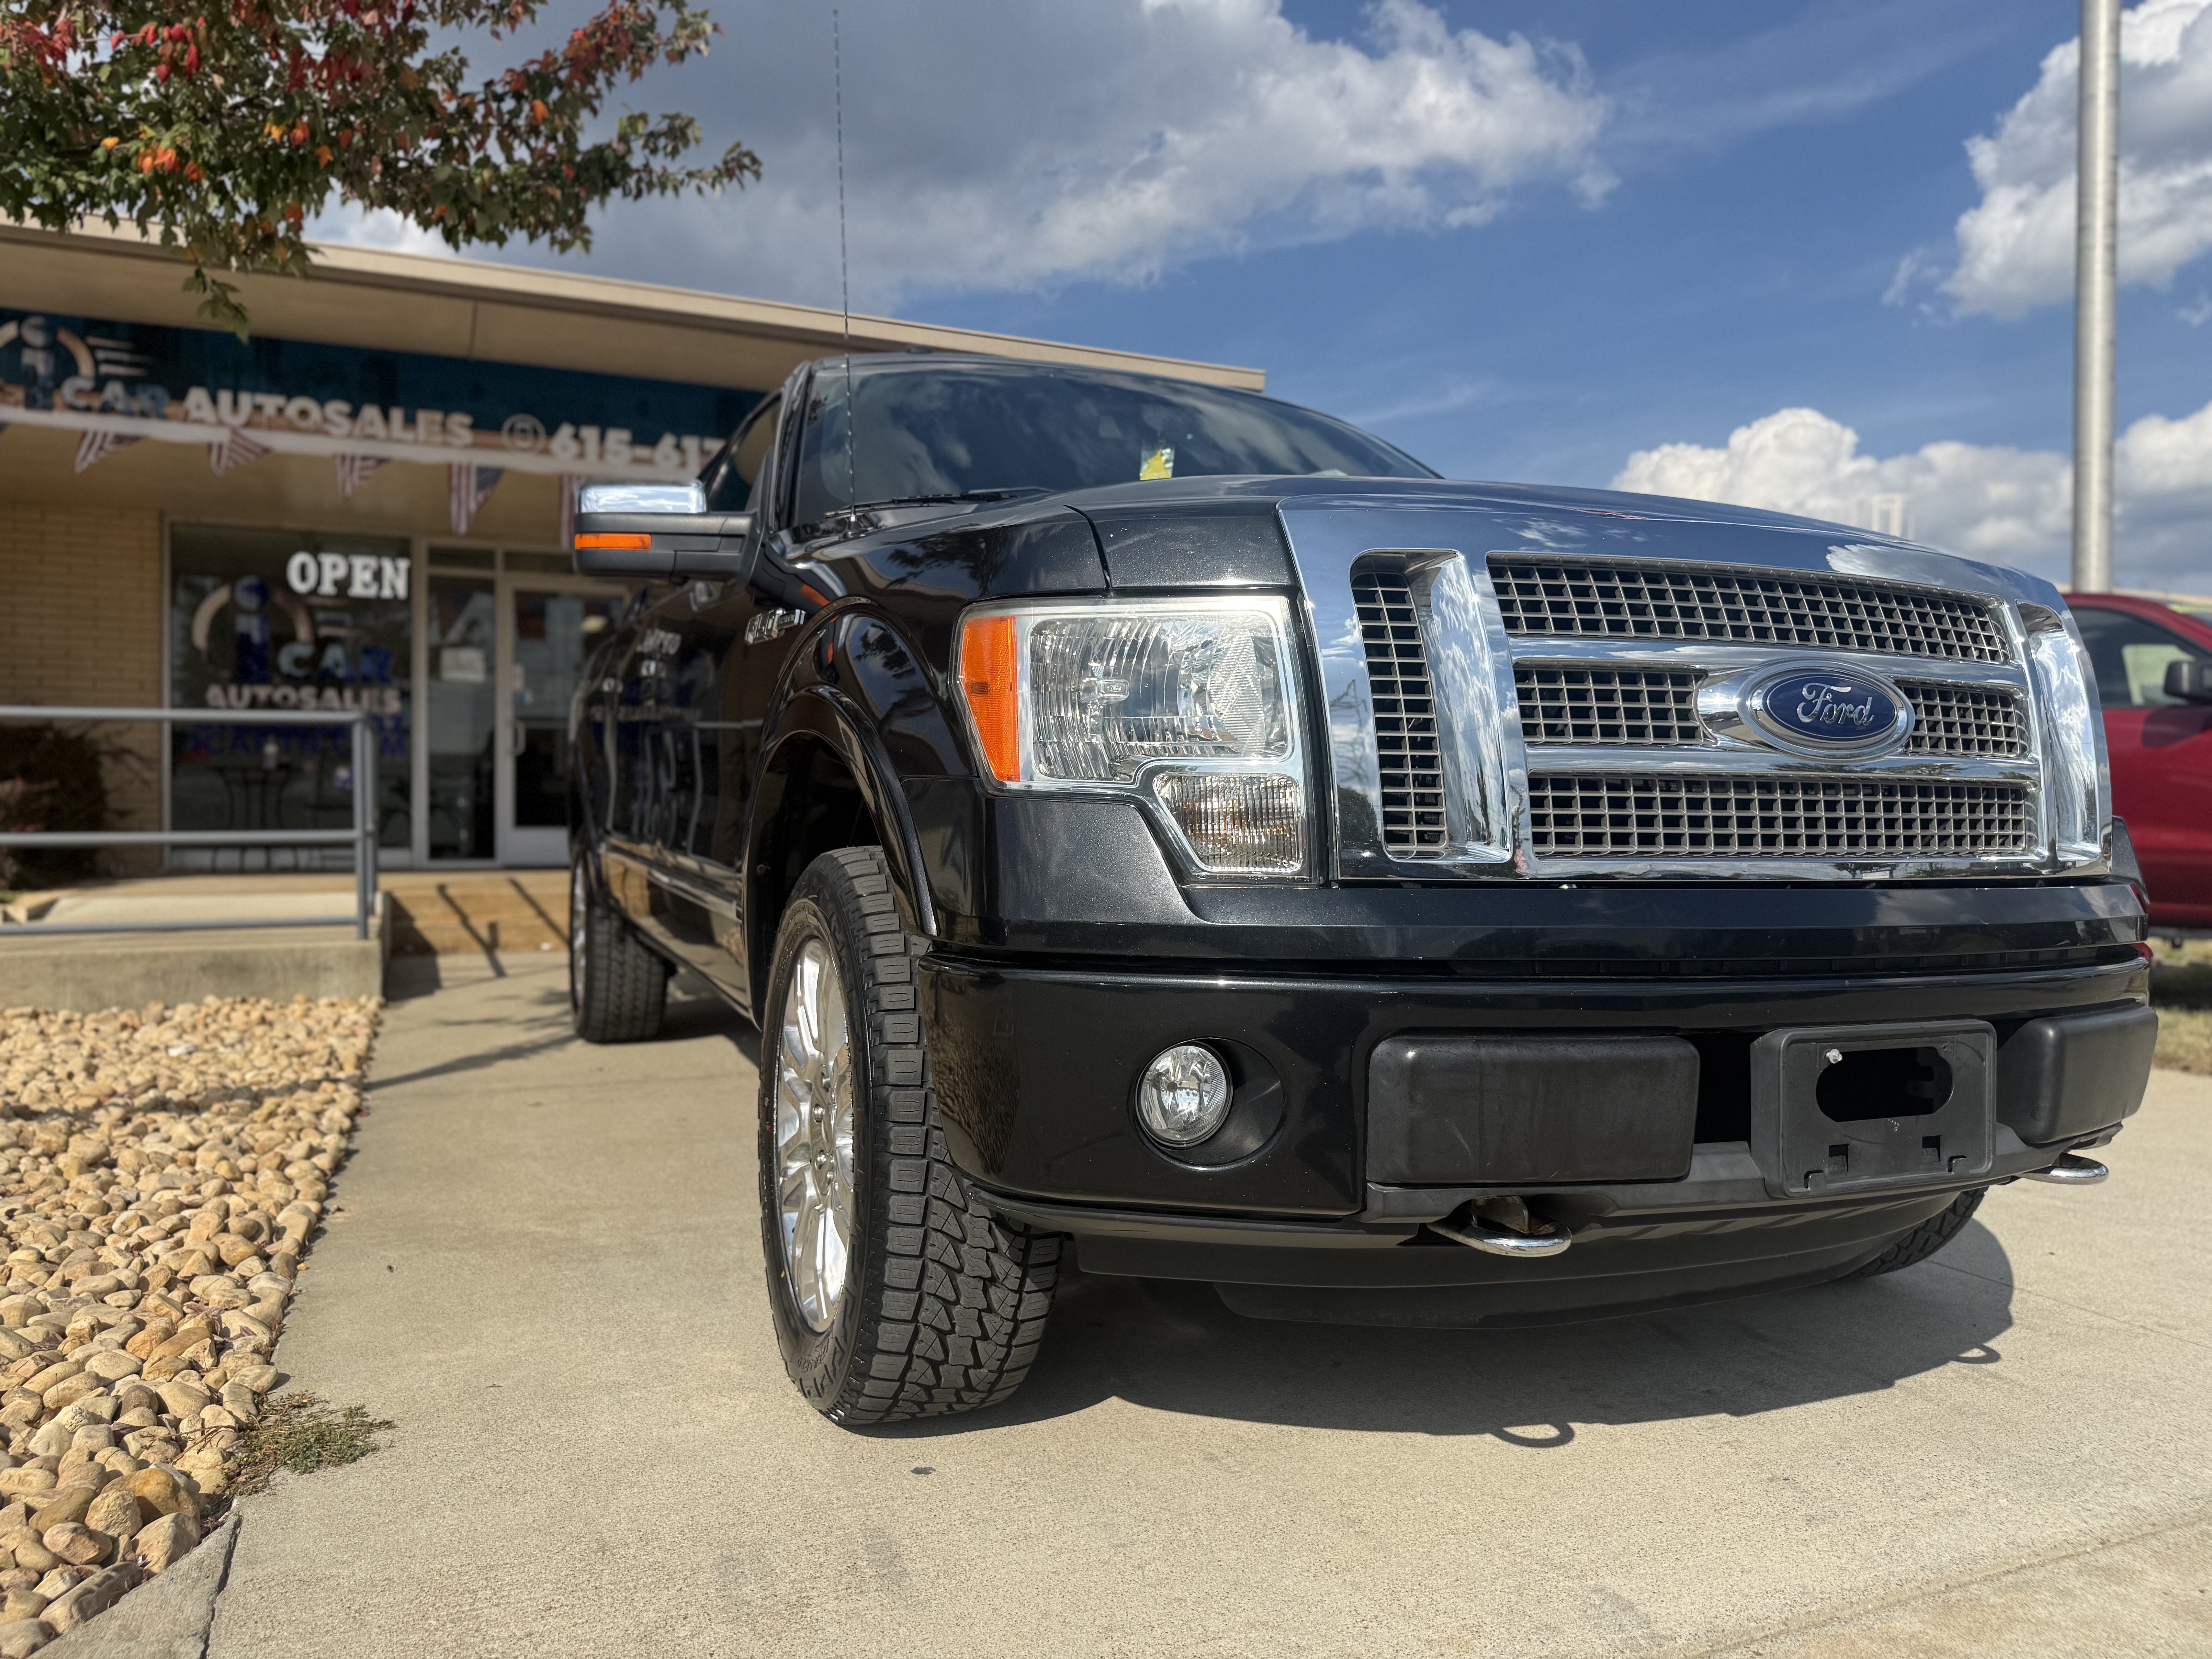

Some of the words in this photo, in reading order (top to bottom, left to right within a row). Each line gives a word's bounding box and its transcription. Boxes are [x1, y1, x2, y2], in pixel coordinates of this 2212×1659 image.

[183, 386, 474, 448] AUTOSALES
[287, 551, 410, 599] OPEN
[205, 684, 402, 714] AUTOSALES
[1797, 682, 1875, 726] Ford
